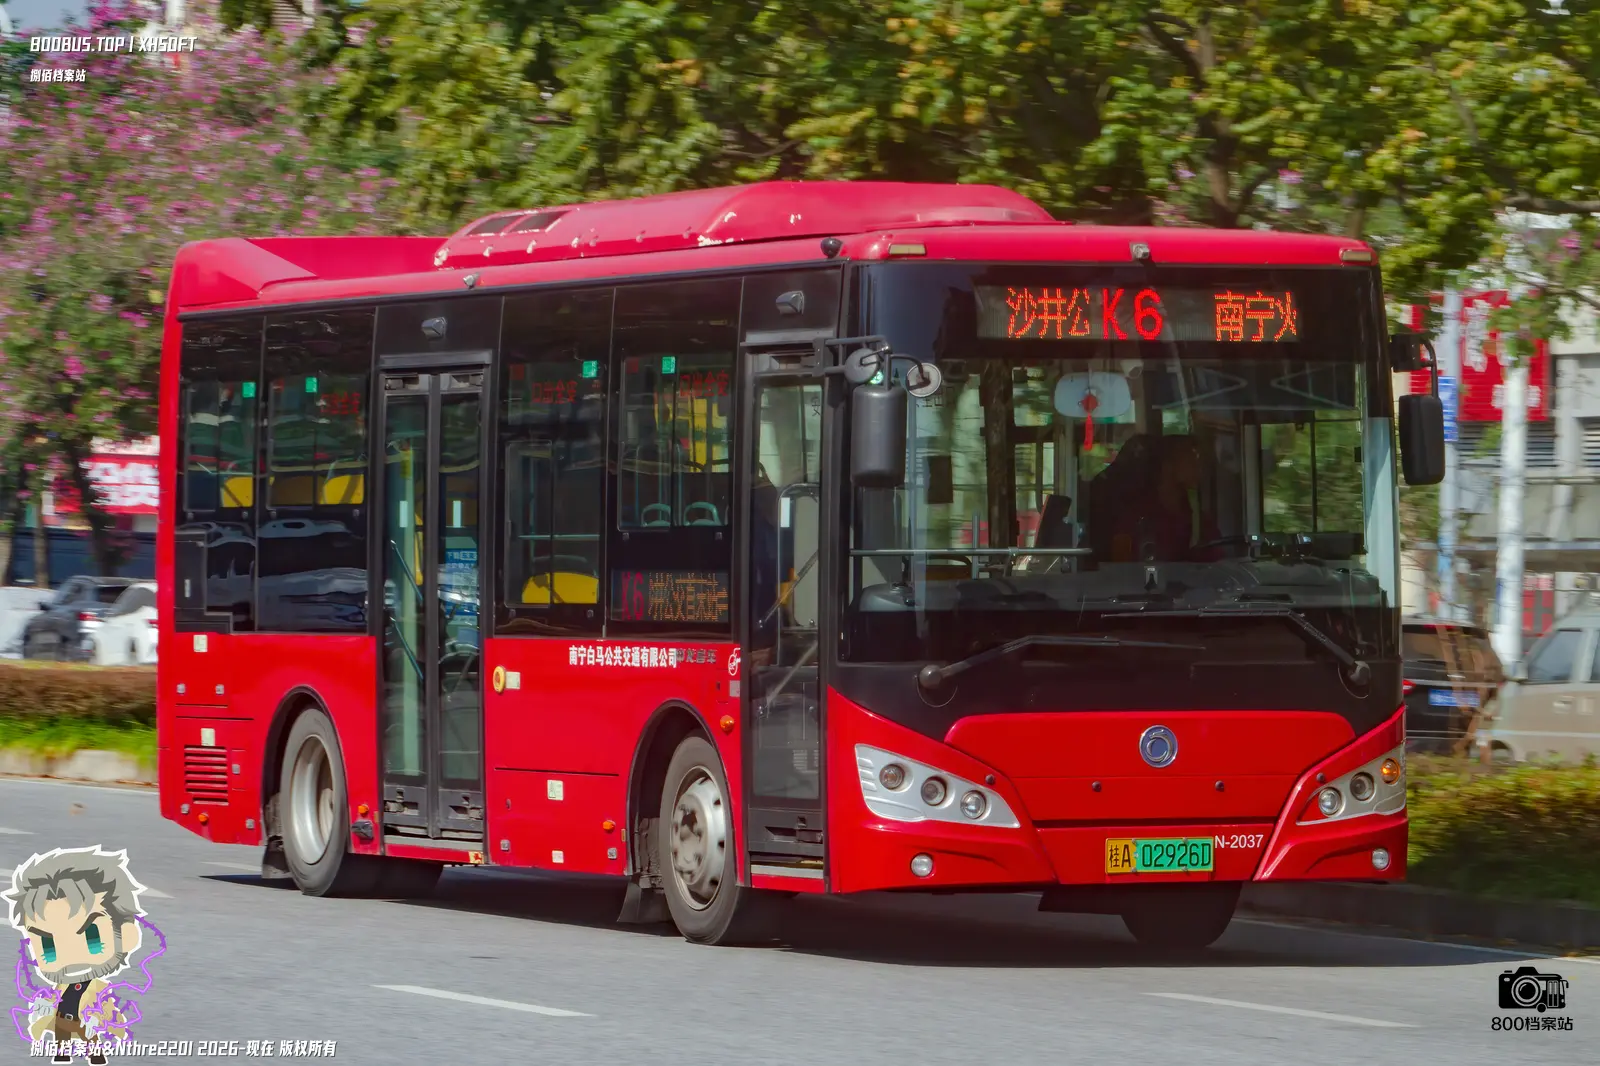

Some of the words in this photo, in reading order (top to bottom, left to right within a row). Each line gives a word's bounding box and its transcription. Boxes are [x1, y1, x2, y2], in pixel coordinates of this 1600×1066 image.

[569, 645, 677, 669] 南宁白马公共交通有限公司
[1214, 835, 1264, 849] N-2037
